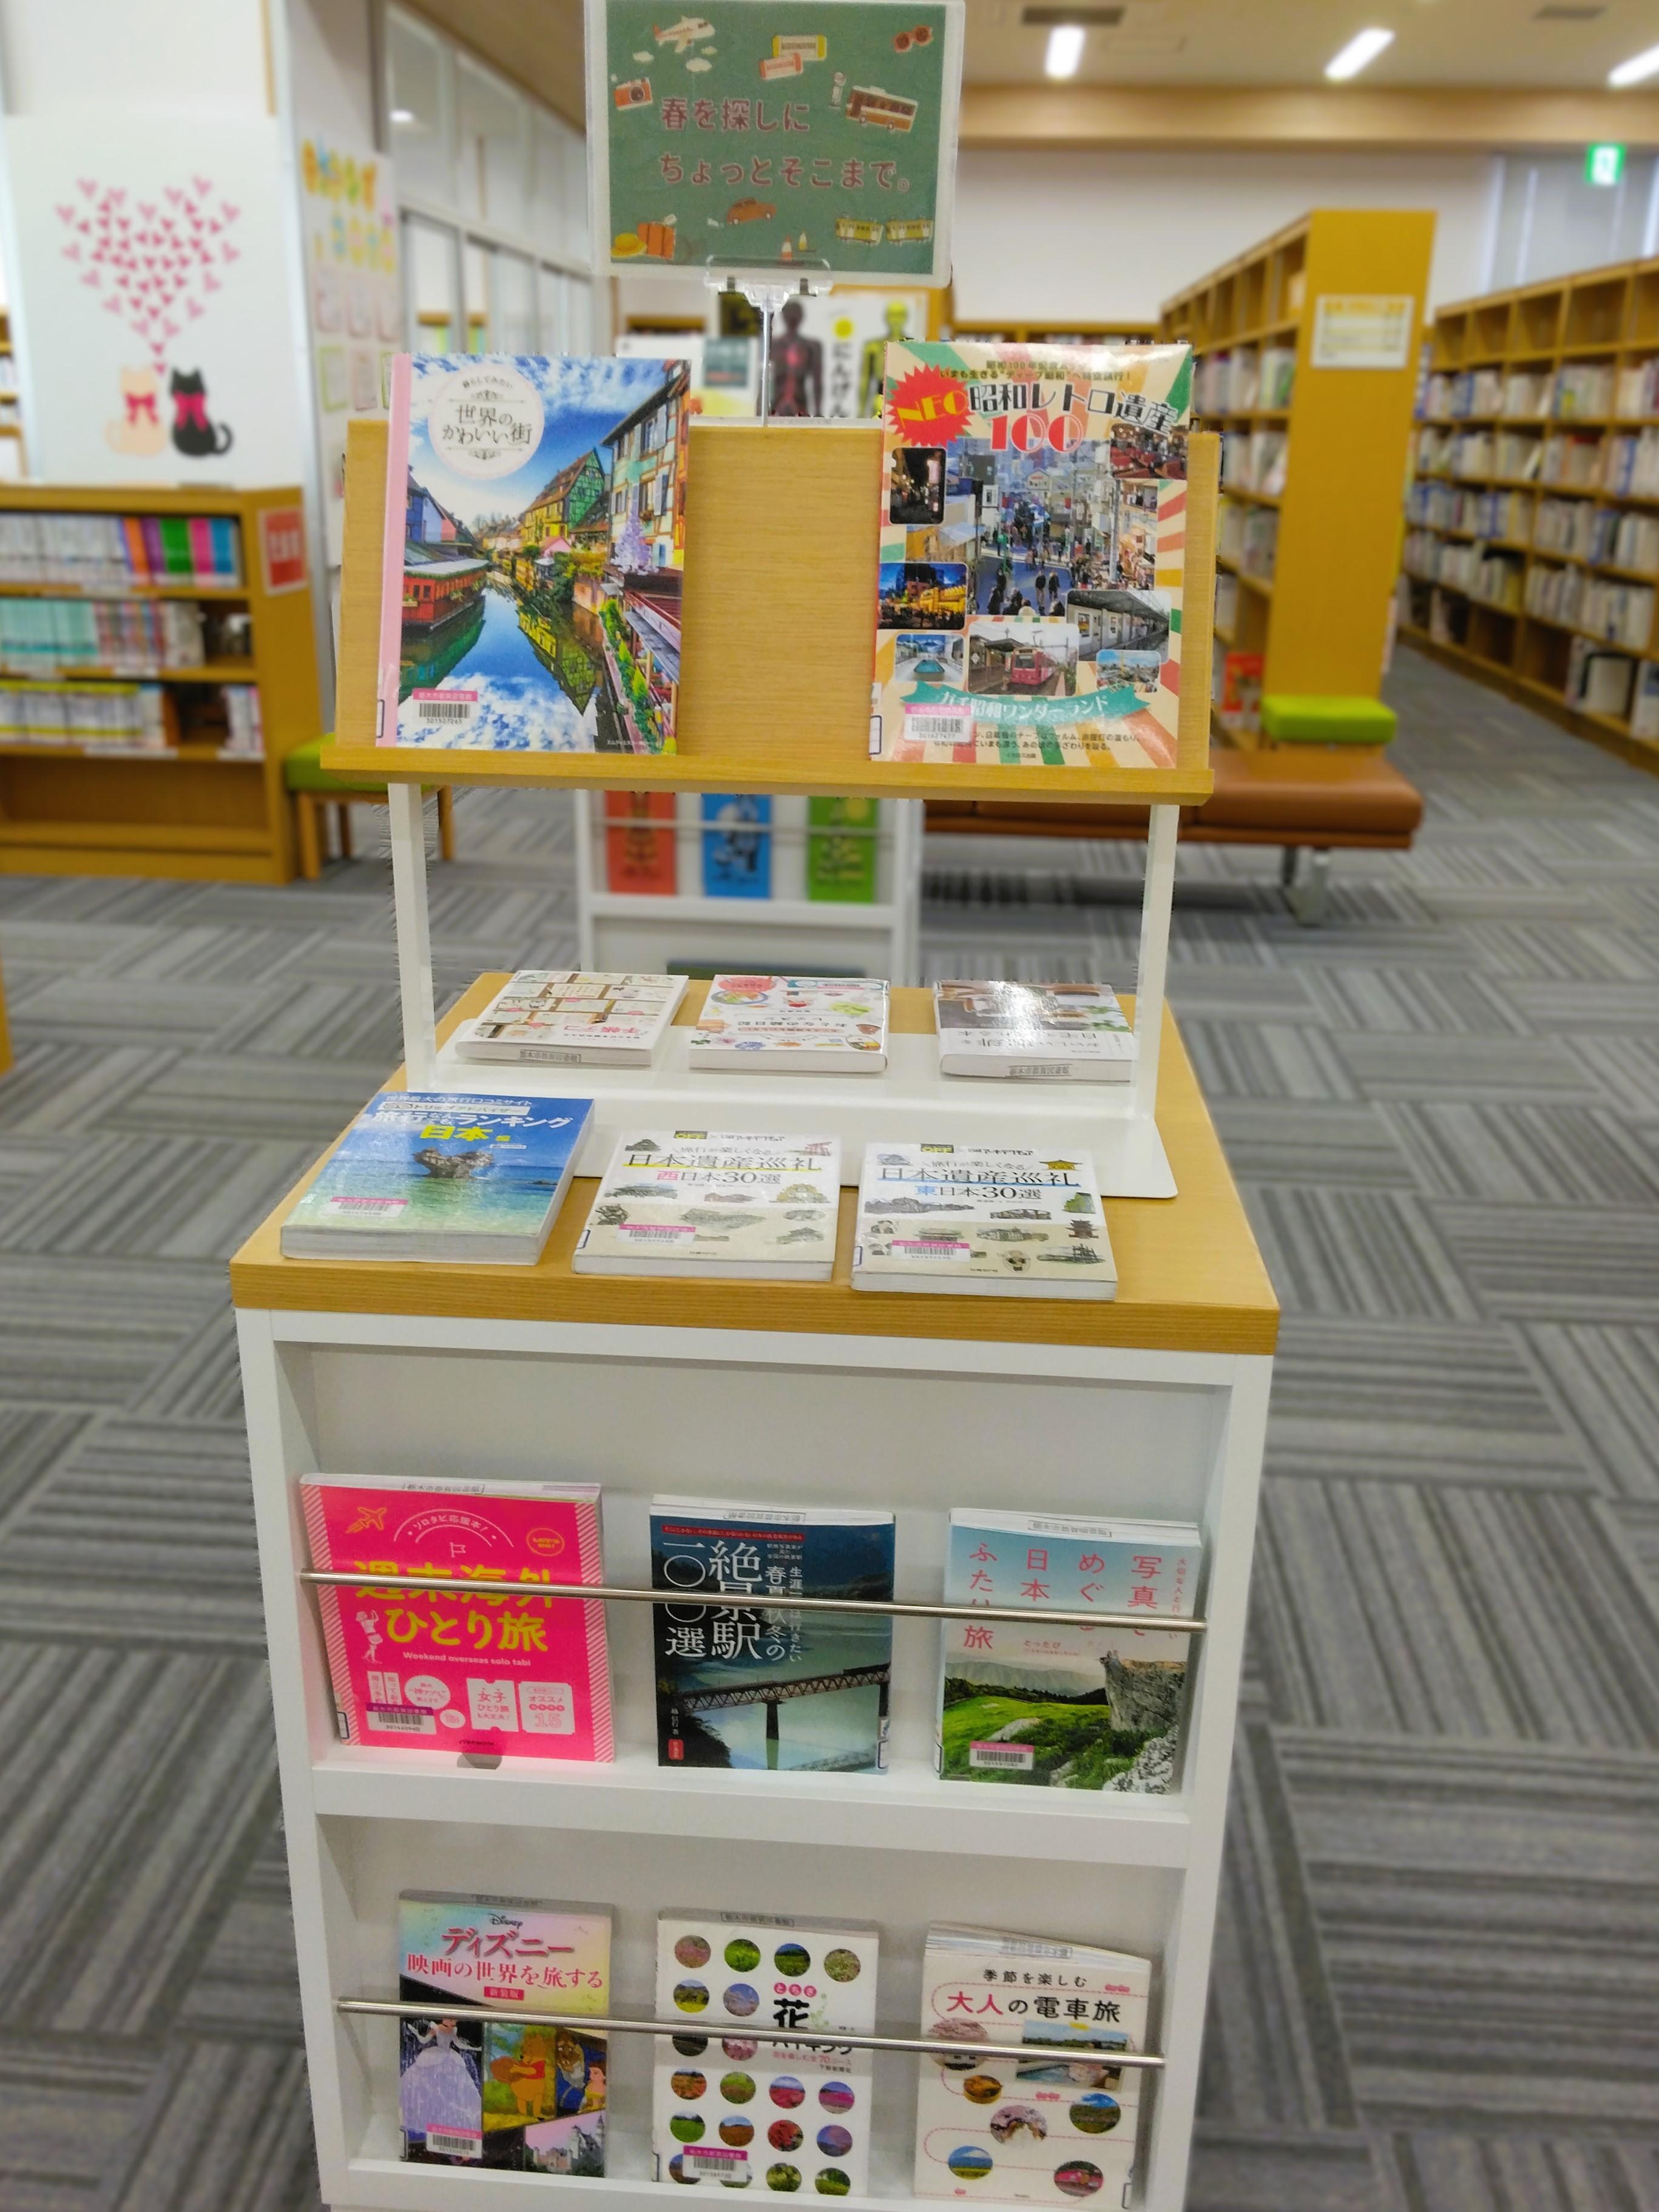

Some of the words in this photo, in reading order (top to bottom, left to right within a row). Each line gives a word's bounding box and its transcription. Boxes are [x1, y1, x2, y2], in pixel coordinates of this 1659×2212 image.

[661, 98, 809, 131] 春を探しに
[660, 154, 909, 192] ちょっとそこまで。
[455, 404, 513, 427] 世界の
[897, 390, 968, 427] NEO
[969, 382, 1178, 437] 昭和レトロ遺産
[442, 422, 532, 445] かわいい街
[991, 414, 1084, 453] 100
[629, 1154, 822, 1172] 日本遺産巡礼
[657, 1170, 782, 1184] 西日本30選
[882, 1167, 1080, 1186] 日本遺産巡礼
[915, 1185, 1042, 1200] 東日本30選
[1020, 1548, 1051, 1602] 日本
[709, 1540, 763, 1660] 絶景駅
[1079, 1553, 1106, 1631] めぐ
[383, 1608, 548, 1651] ひとり旅
[403, 1651, 447, 1661] Weekend
[448, 1655, 488, 1664] overseas
[478, 1688, 506, 1702] 女子
[478, 1704, 510, 1713] ひとり旅
[535, 1713, 562, 1728] 15
[487, 1913, 524, 1930] Disney
[442, 1927, 575, 1958] ディズニー
[407, 1953, 604, 1989] 映画の世界を旅する
[983, 1968, 1087, 1988] 季節を楽しむ
[773, 1998, 810, 2029] 花
[947, 1991, 1121, 2023] 大人の電車旅
